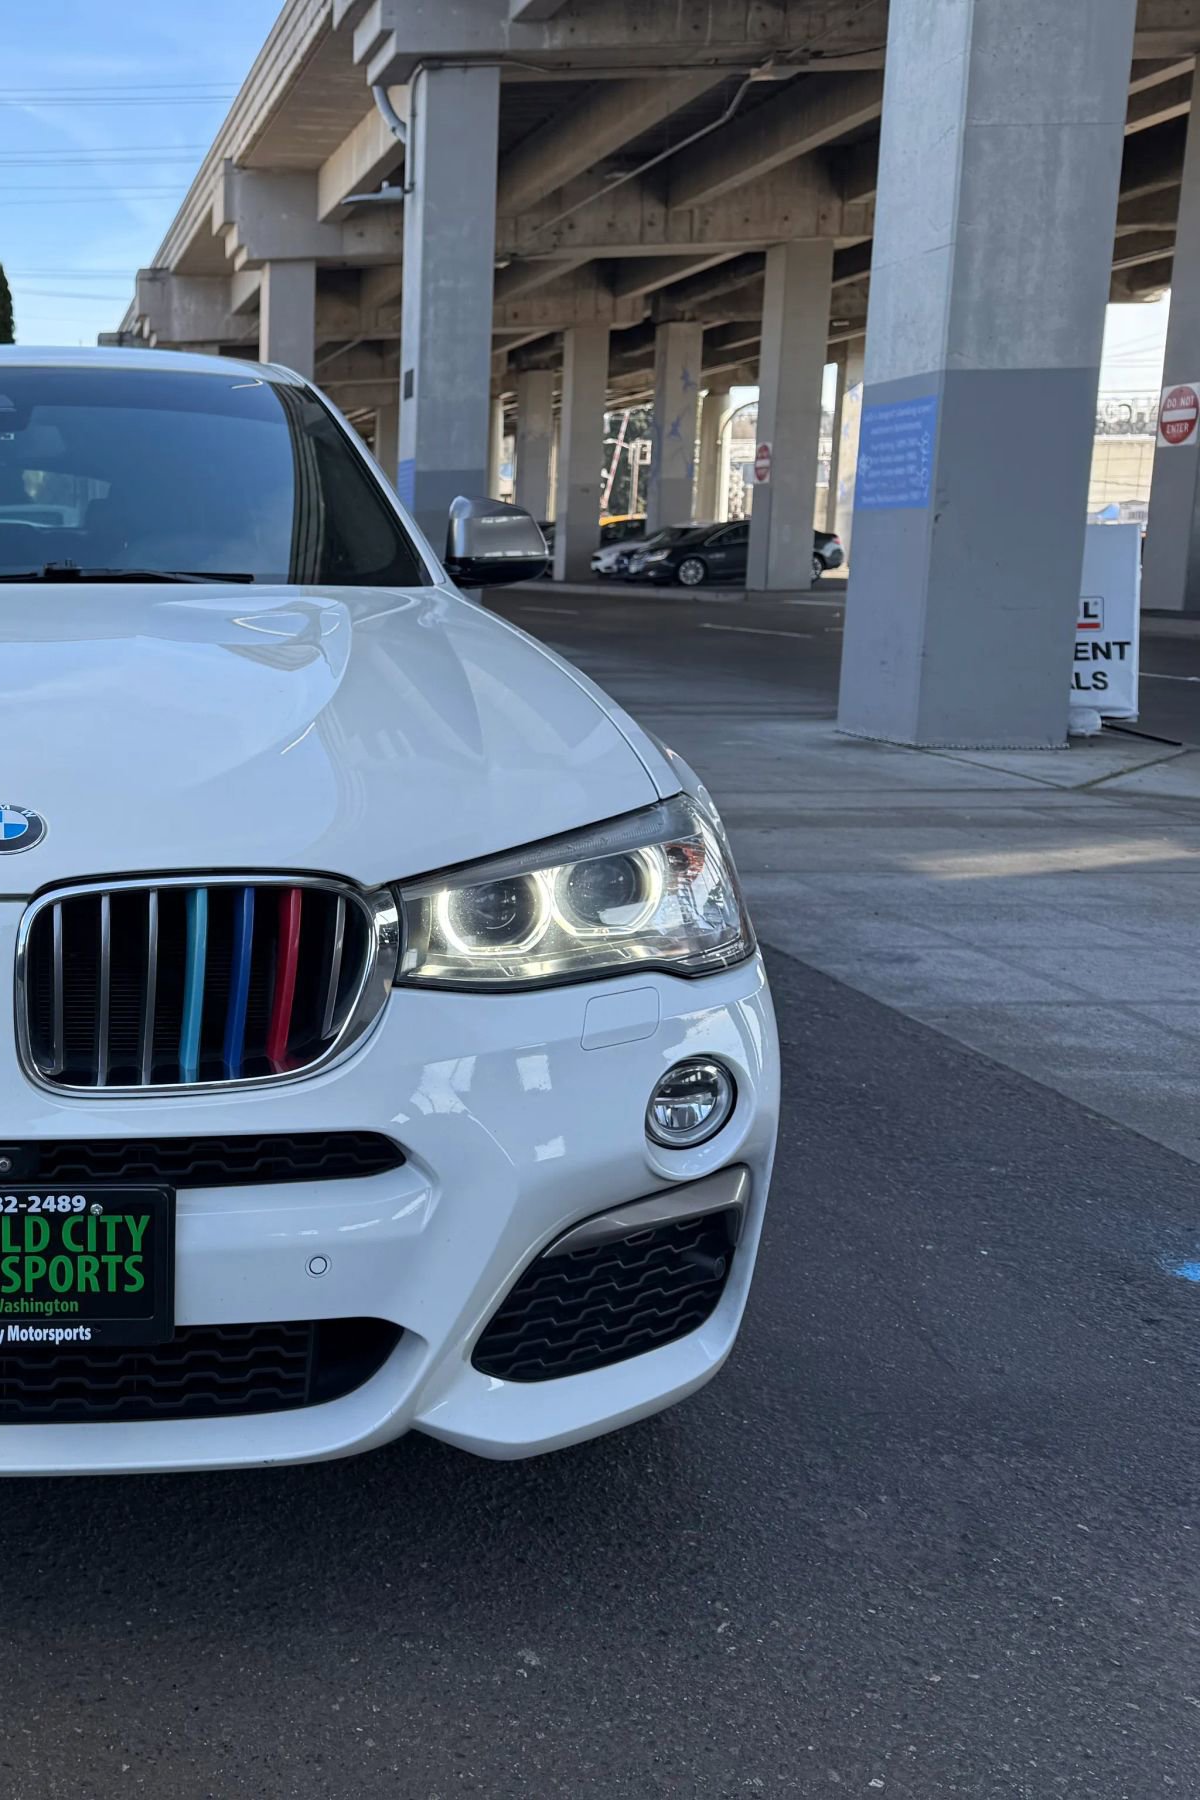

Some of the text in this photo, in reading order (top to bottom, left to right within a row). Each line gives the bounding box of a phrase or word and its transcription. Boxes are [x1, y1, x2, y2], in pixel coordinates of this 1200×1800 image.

[1166, 395, 1195, 409] DO NOT
[1166, 422, 1189, 434] ENTER
[61, 1214, 151, 1253] CITY
[7, 1324, 92, 1345] Motorsports
